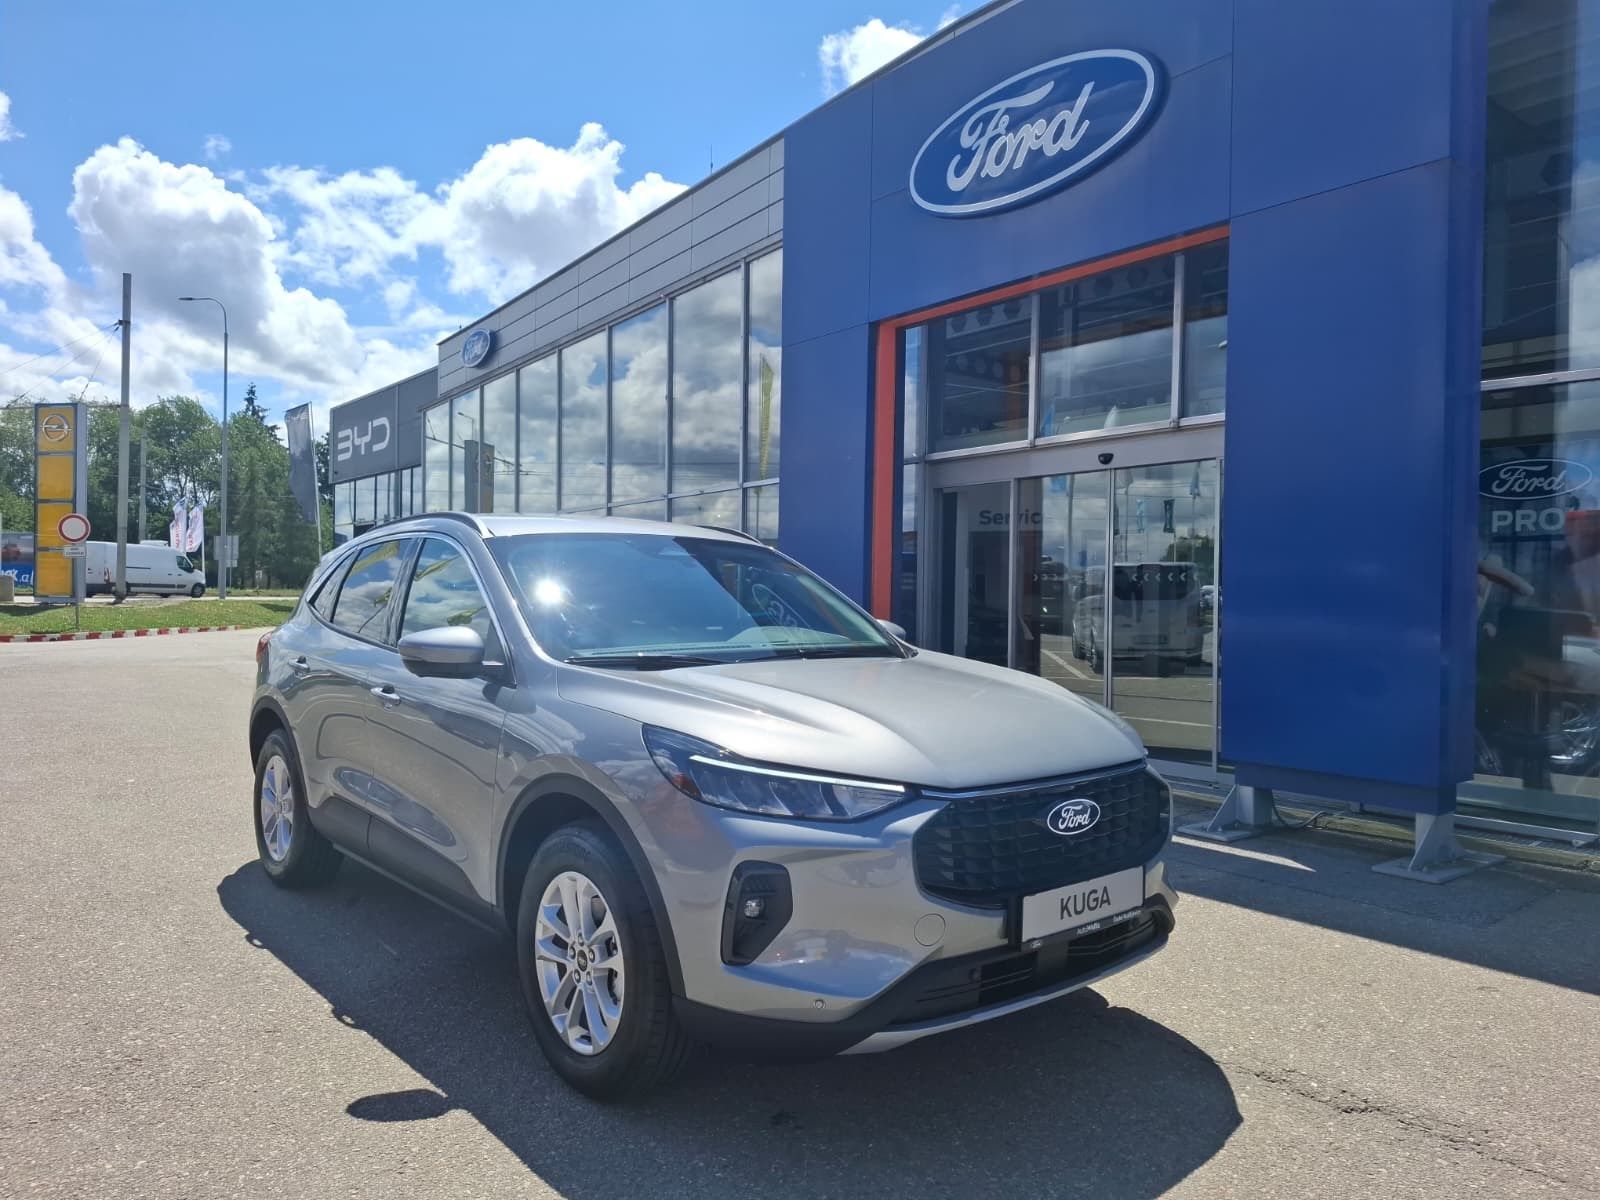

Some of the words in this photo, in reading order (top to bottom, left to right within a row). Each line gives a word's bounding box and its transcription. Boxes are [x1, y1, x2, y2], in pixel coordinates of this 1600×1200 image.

[946, 80, 1095, 192] Ford
[337, 416, 391, 462] BYD
[1492, 465, 1567, 493] Ford
[1491, 507, 1565, 533] PRO
[1058, 804, 1091, 830] Ford
[1060, 886, 1111, 920] KUGA
